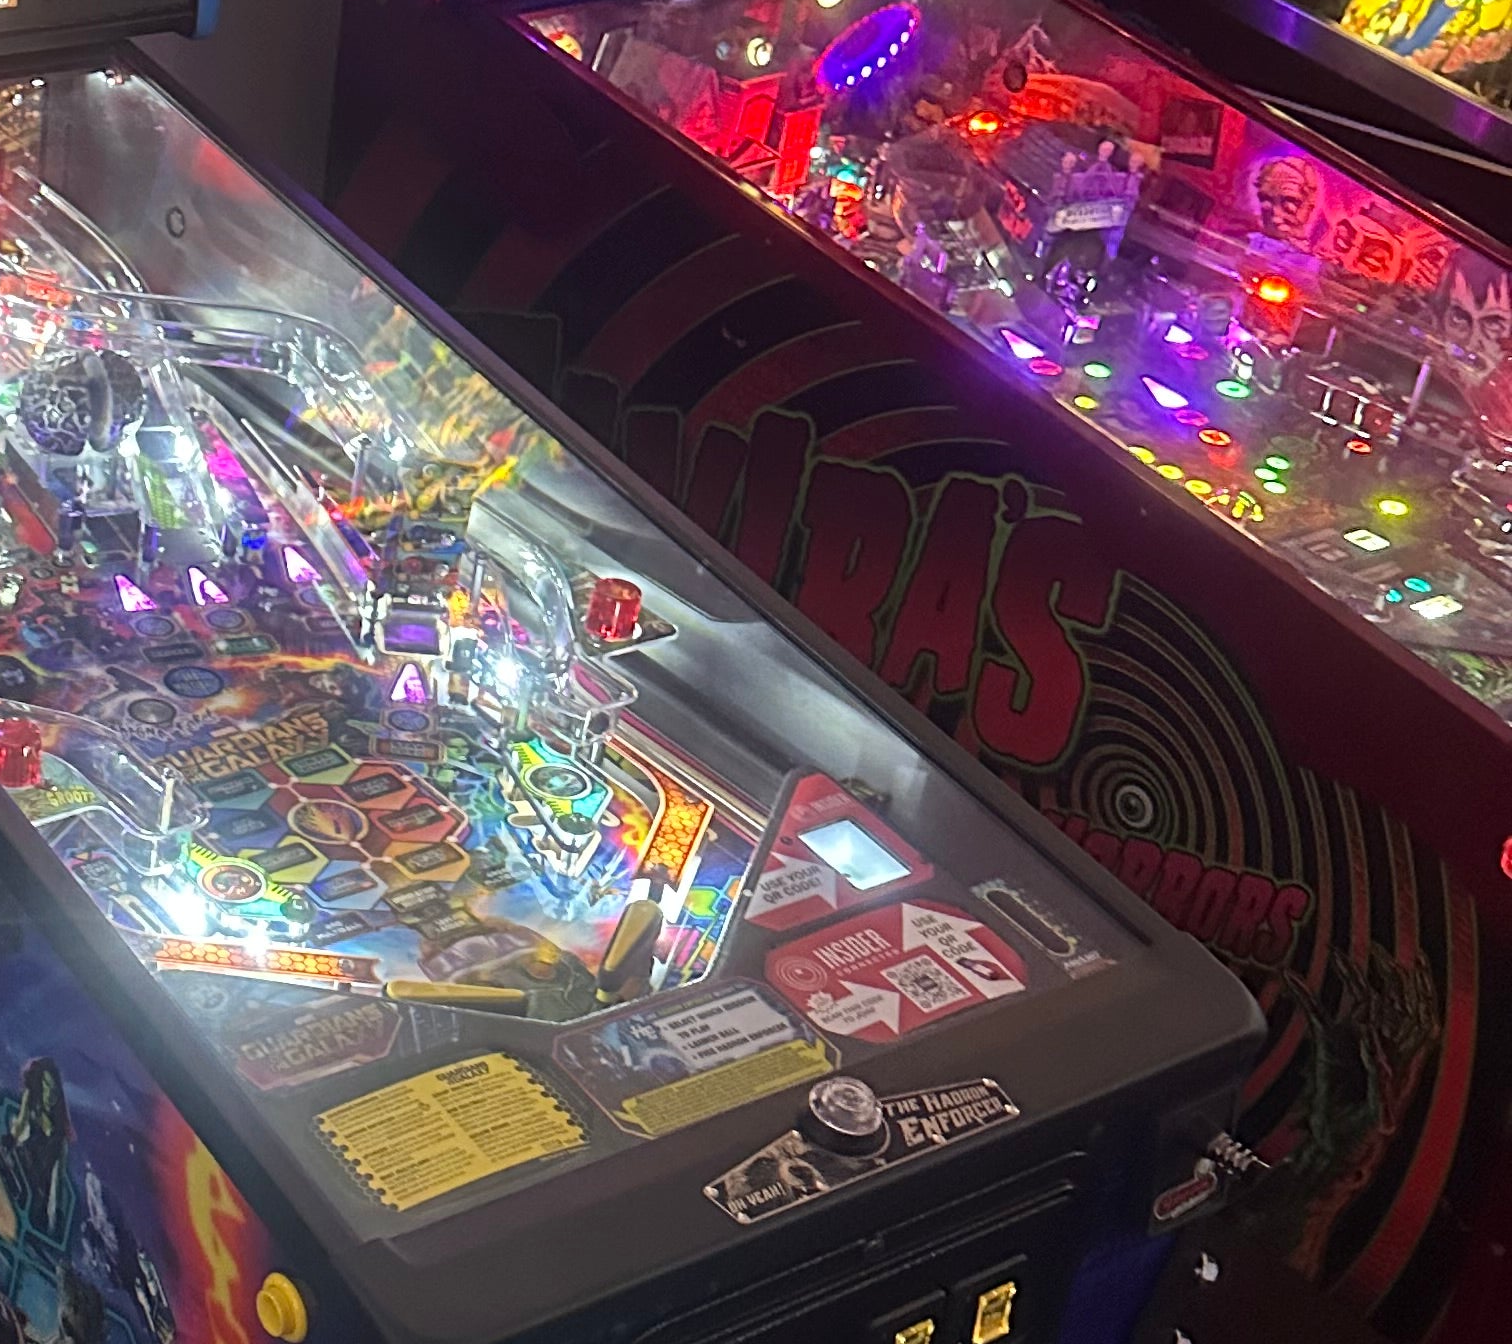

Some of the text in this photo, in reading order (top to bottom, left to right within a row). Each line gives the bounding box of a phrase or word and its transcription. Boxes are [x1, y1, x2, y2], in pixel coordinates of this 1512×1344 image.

[759, 865, 822, 893] USE YOUR
[763, 877, 822, 905] QR CODE!
[911, 913, 937, 928] USE
[918, 922, 952, 939] YOUR
[812, 929, 891, 971] INSIDER
[938, 935, 958, 949] QR
[942, 942, 977, 958] CODE
[721, 1026, 740, 1039] BALL
[888, 1086, 990, 1117] THE HADRON
[897, 1096, 1005, 1147] ENFORCER
[727, 1192, 747, 1214] OH
